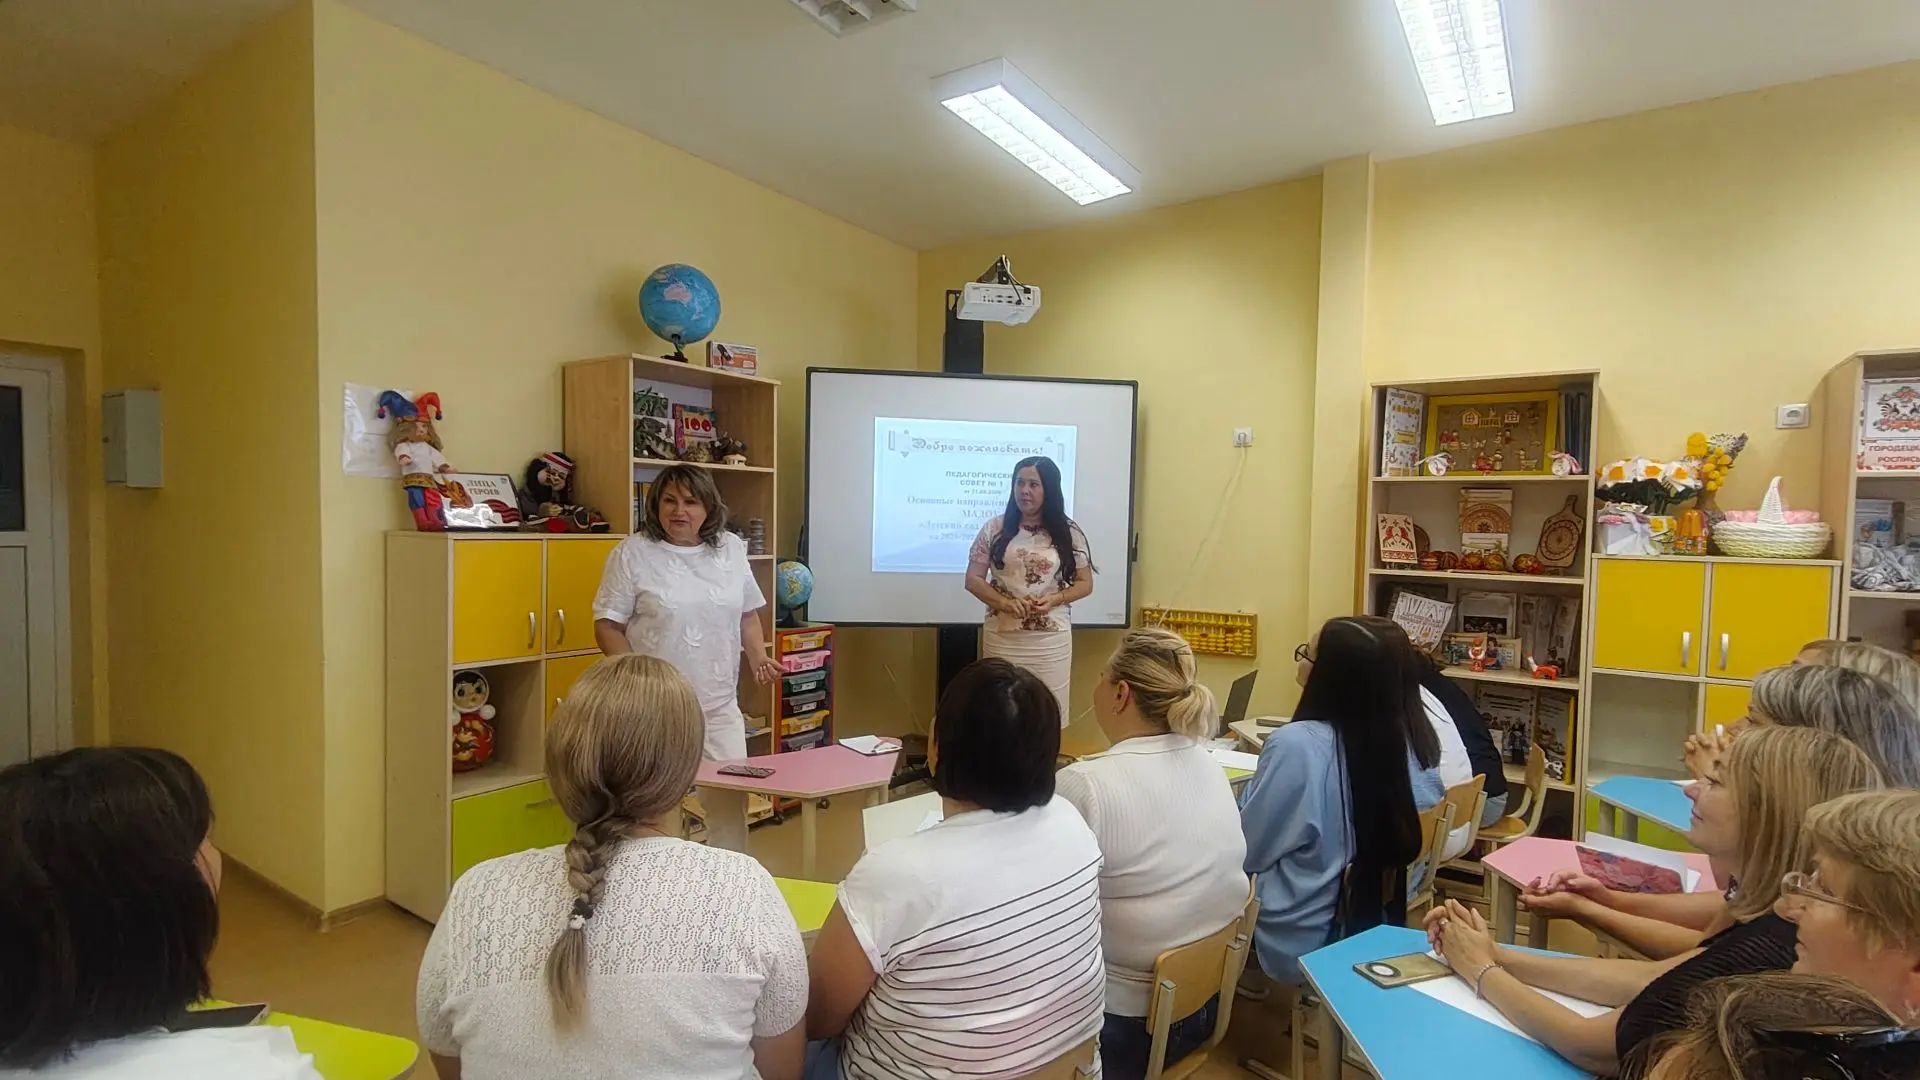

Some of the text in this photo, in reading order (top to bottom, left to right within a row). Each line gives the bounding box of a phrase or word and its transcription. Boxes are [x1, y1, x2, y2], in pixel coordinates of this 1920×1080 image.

[684, 417, 712, 432] 100
[911, 437, 954, 453] Добро
[945, 470, 1013, 480] ПЕДАГОГИЧЕСКИ
[467, 480, 497, 488] ЛИЦА
[959, 479, 986, 488] СОВЕТ
[907, 496, 1009, 508] Основные направлен
